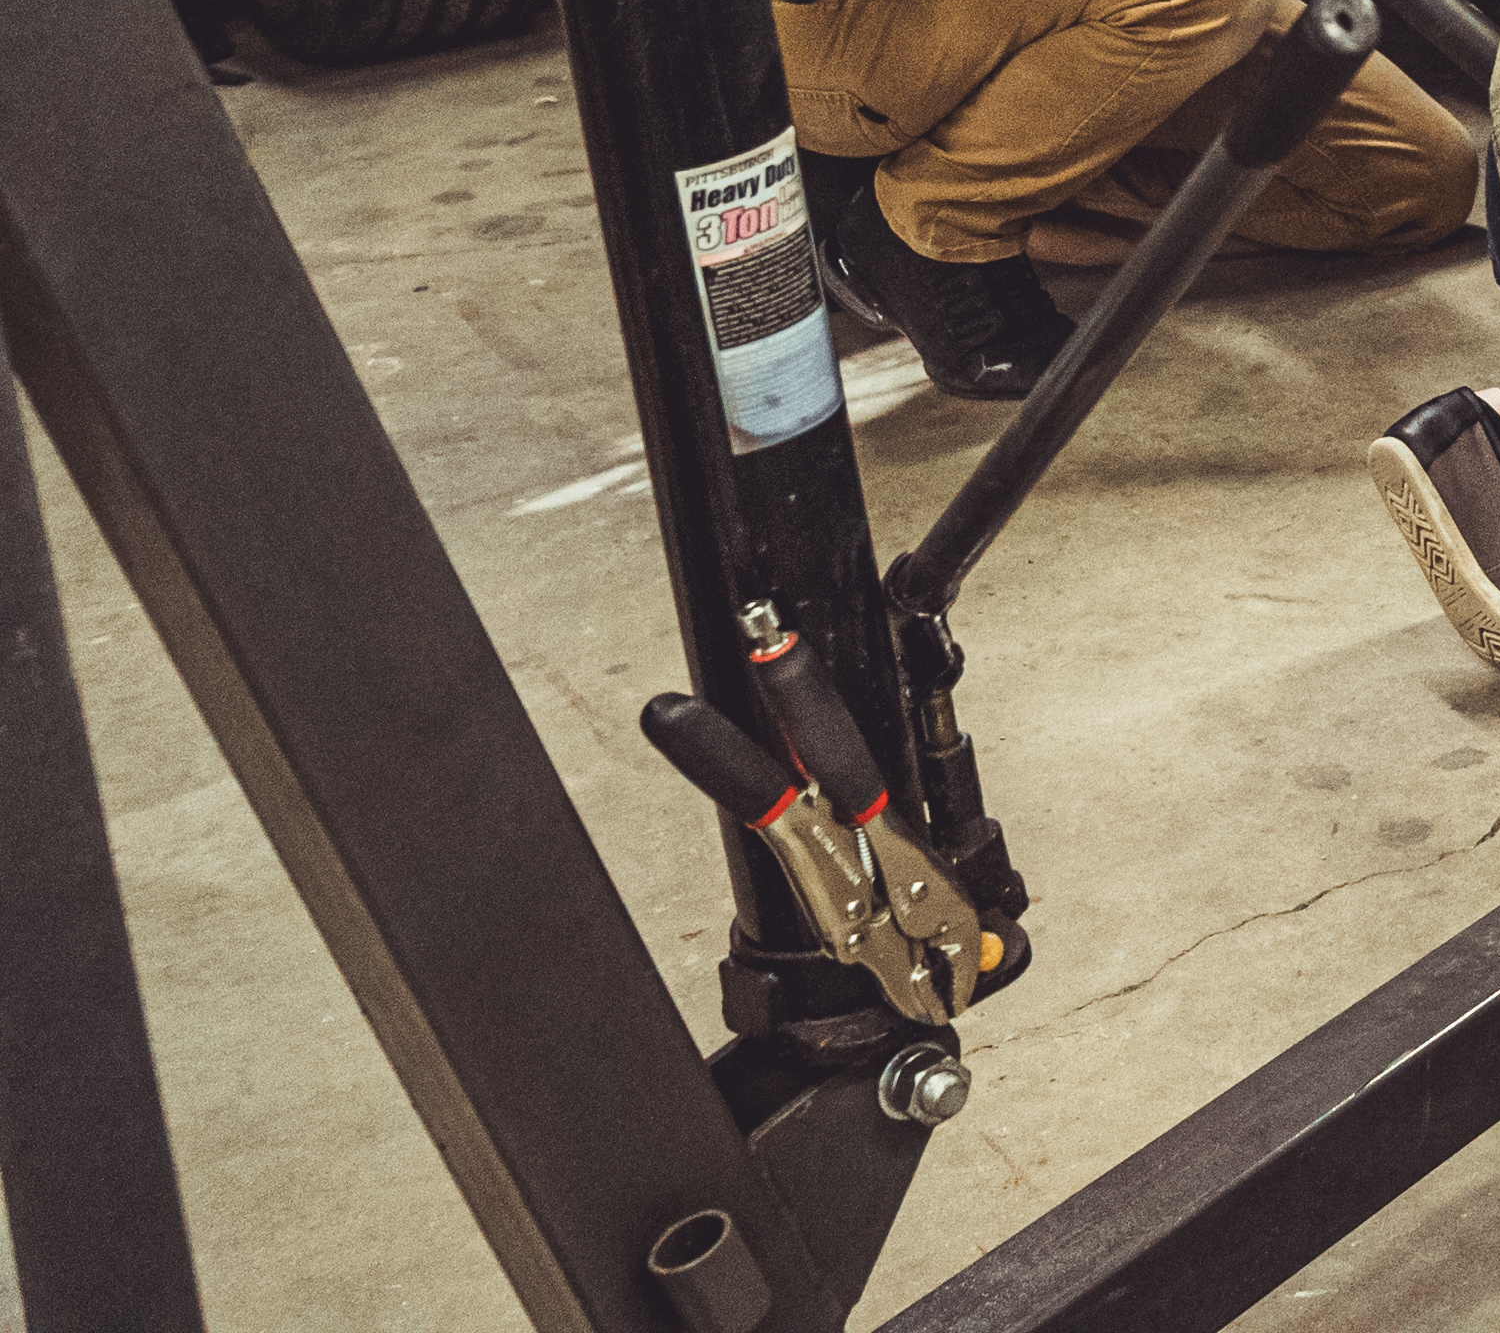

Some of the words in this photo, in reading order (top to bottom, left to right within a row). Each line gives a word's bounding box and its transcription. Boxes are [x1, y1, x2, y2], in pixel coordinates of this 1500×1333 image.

[684, 148, 775, 188] PITTSBURGH
[691, 173, 760, 213] Heavy
[695, 213, 722, 251] 3
[720, 197, 779, 245] Ton
